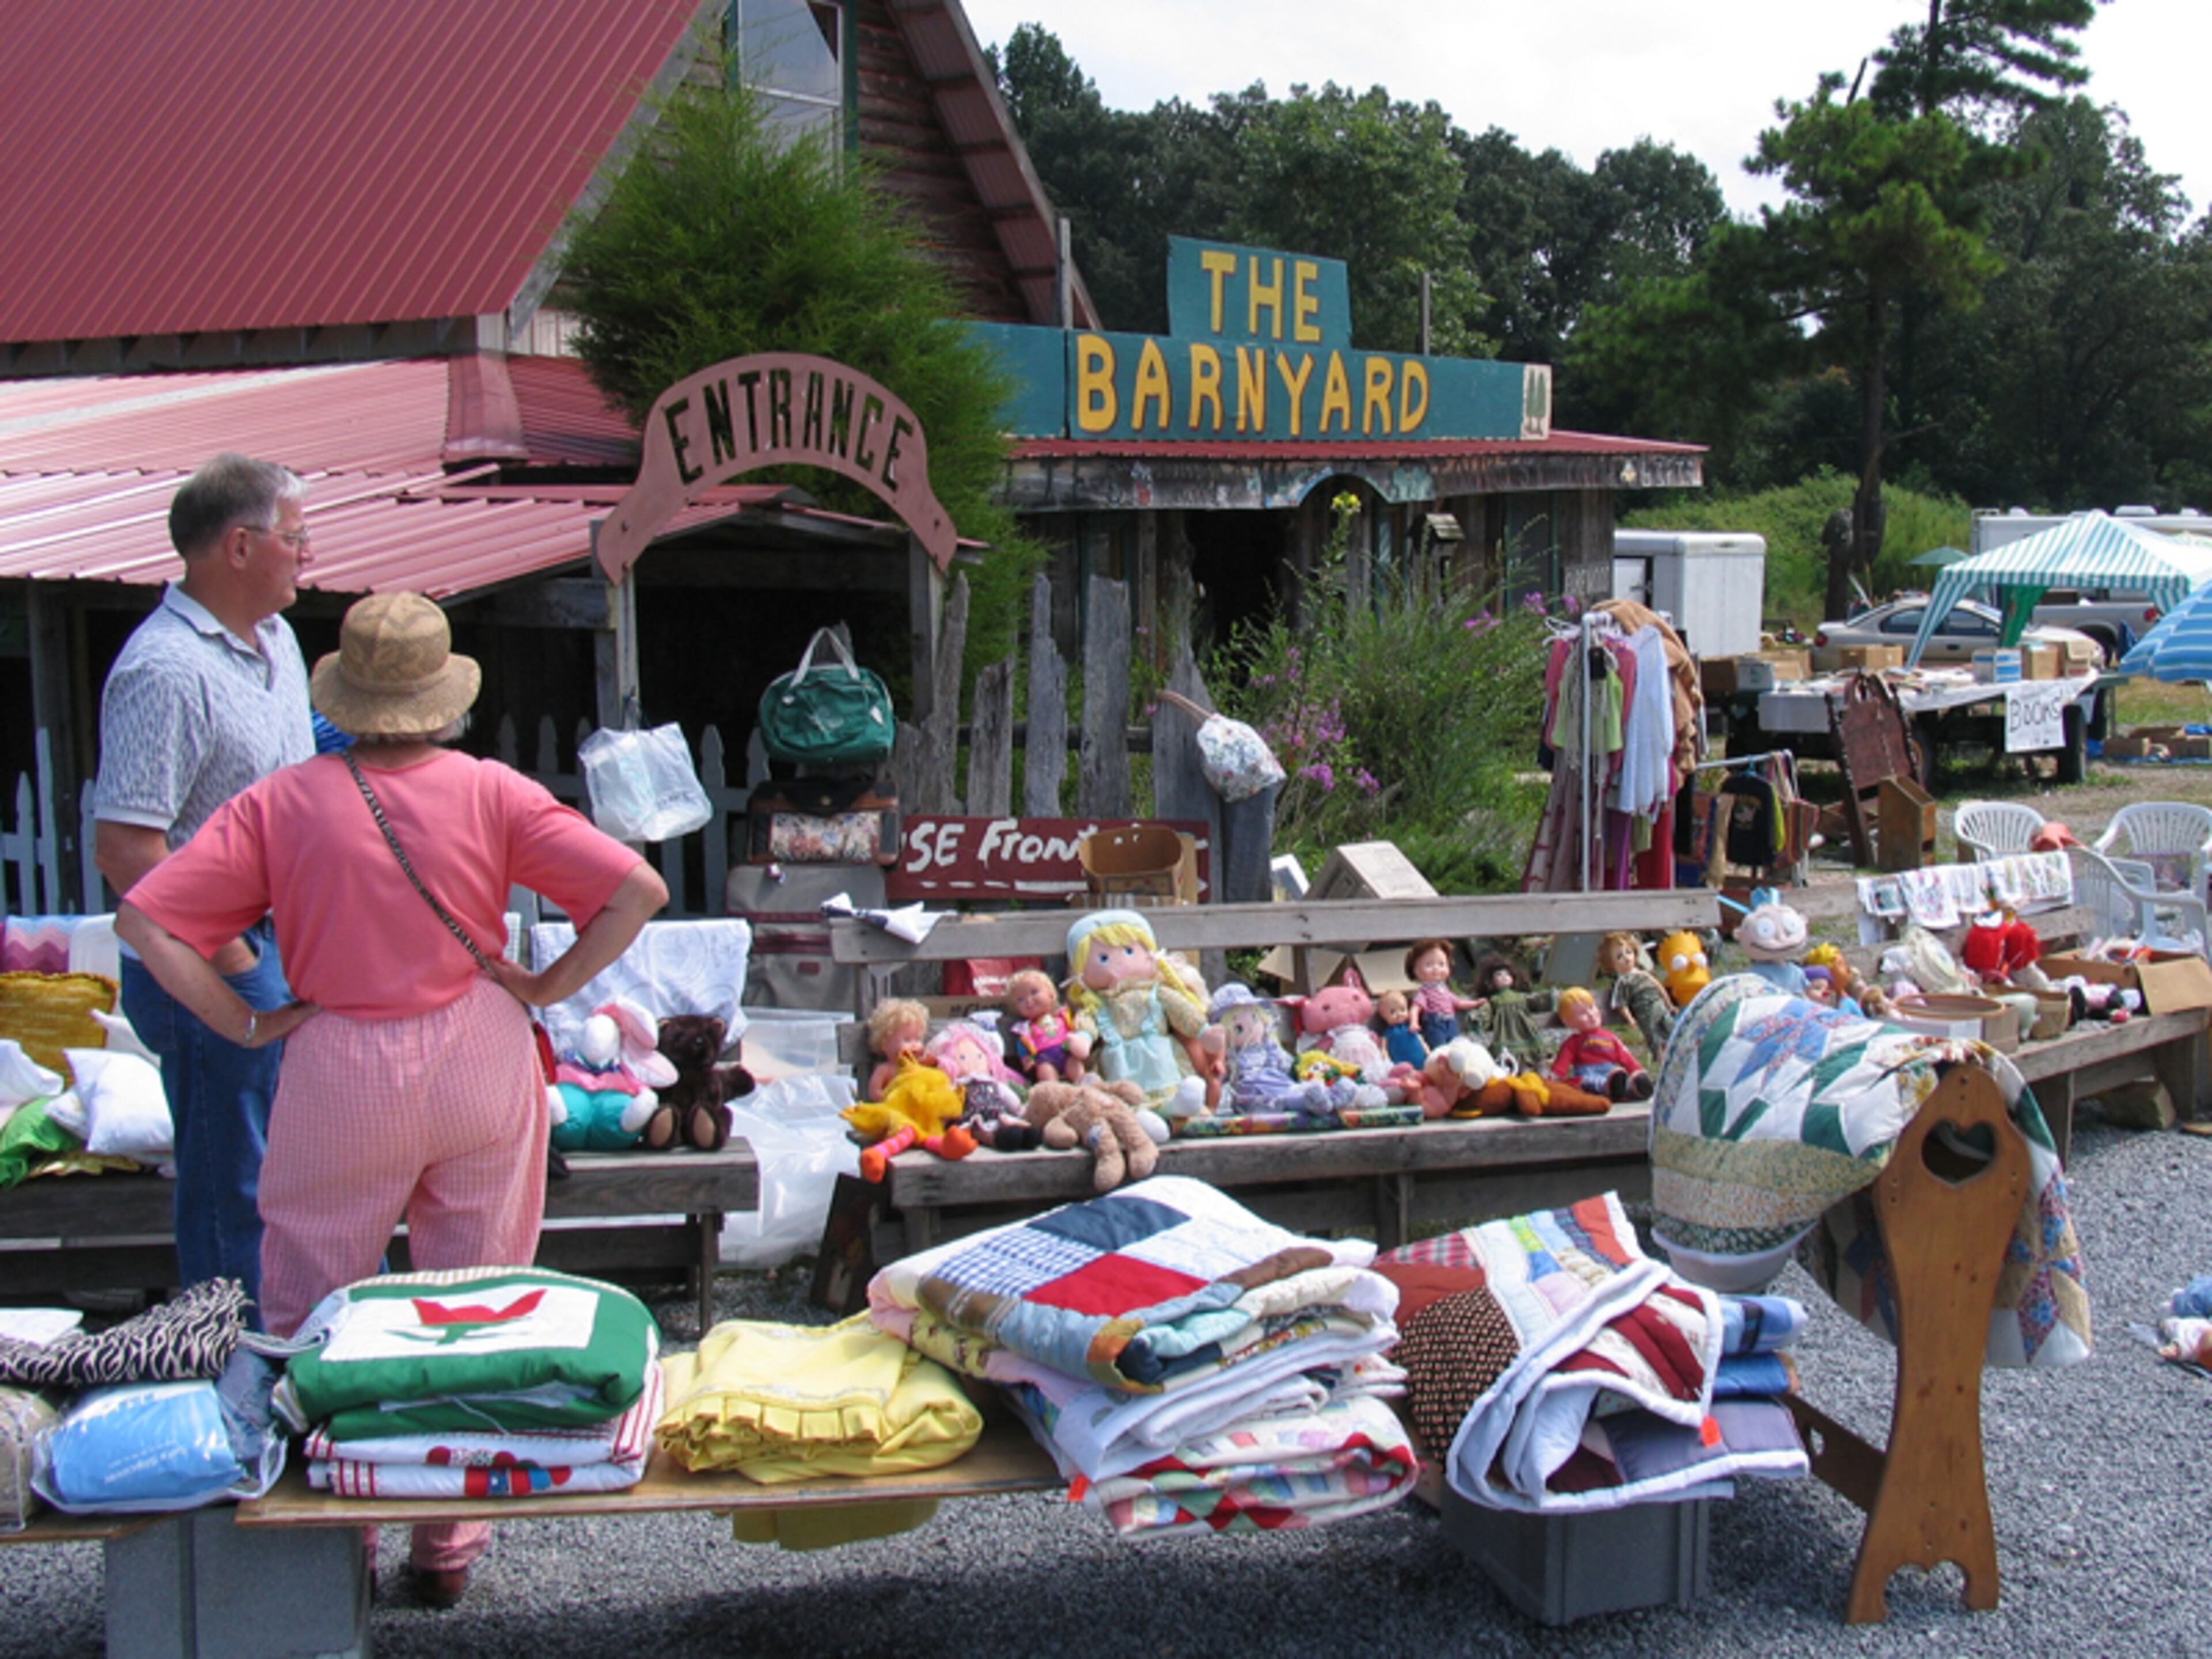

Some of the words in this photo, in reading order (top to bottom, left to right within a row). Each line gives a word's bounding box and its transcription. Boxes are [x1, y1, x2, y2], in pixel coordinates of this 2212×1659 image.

[1200, 250, 1321, 342] THE
[662, 368, 915, 493] ENTRANCE
[1076, 333, 1430, 436] BARNYARD
[901, 822, 965, 873] SE
